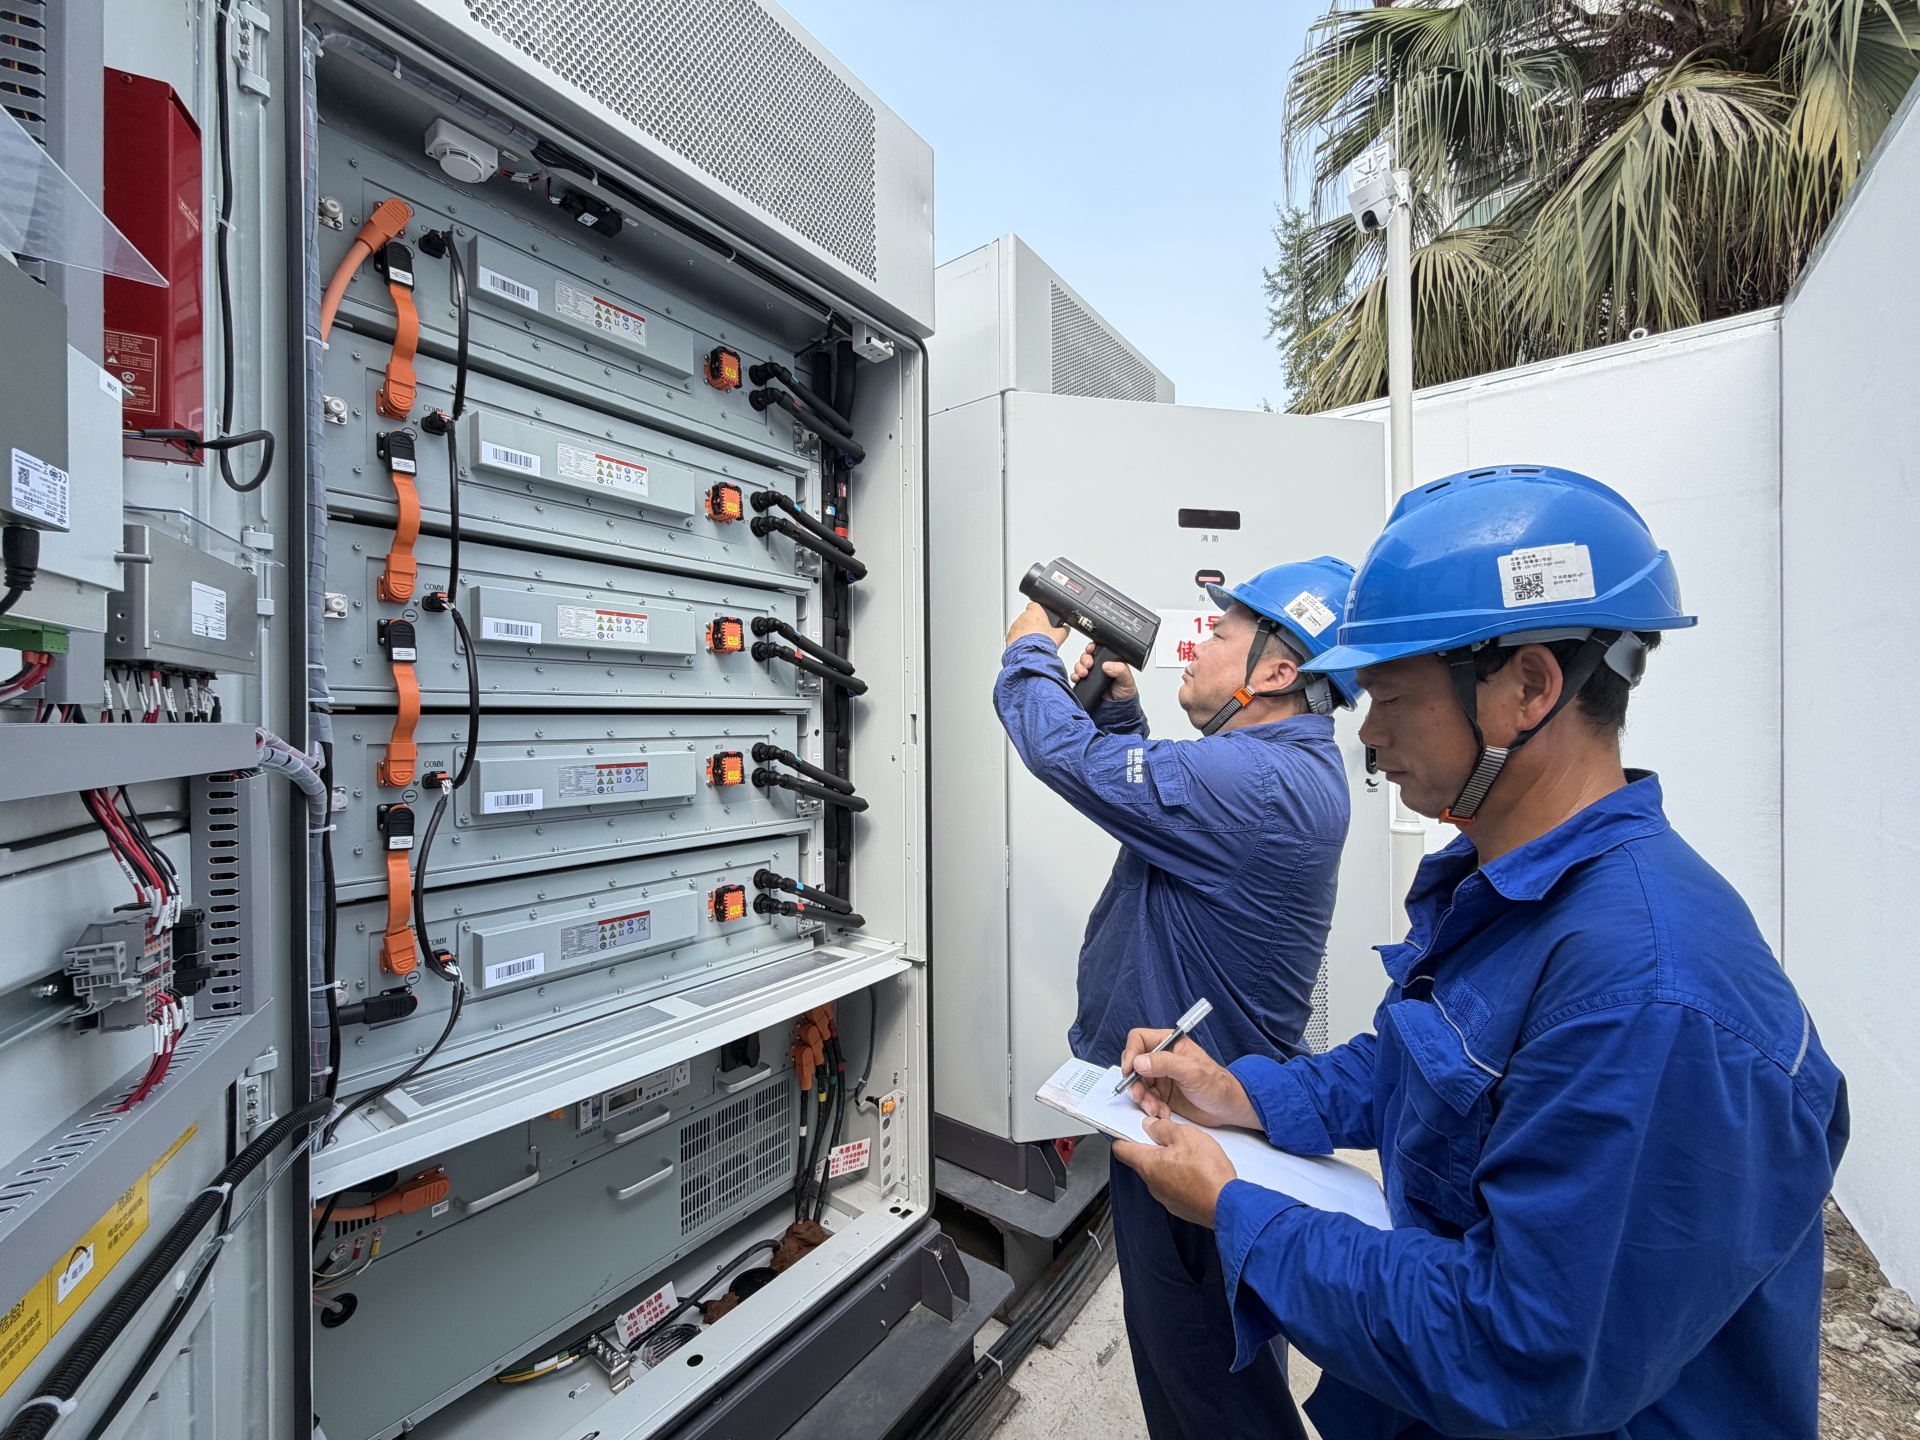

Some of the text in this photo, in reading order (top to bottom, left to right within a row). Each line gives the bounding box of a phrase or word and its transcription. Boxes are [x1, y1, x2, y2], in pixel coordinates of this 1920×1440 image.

[1200, 534, 1220, 543] 消防
[424, 583, 444, 591] COMM
[424, 760, 444, 769] COMM
[1133, 747, 1144, 784] 国家电网
[627, 1292, 663, 1321] 电缆吊牌
